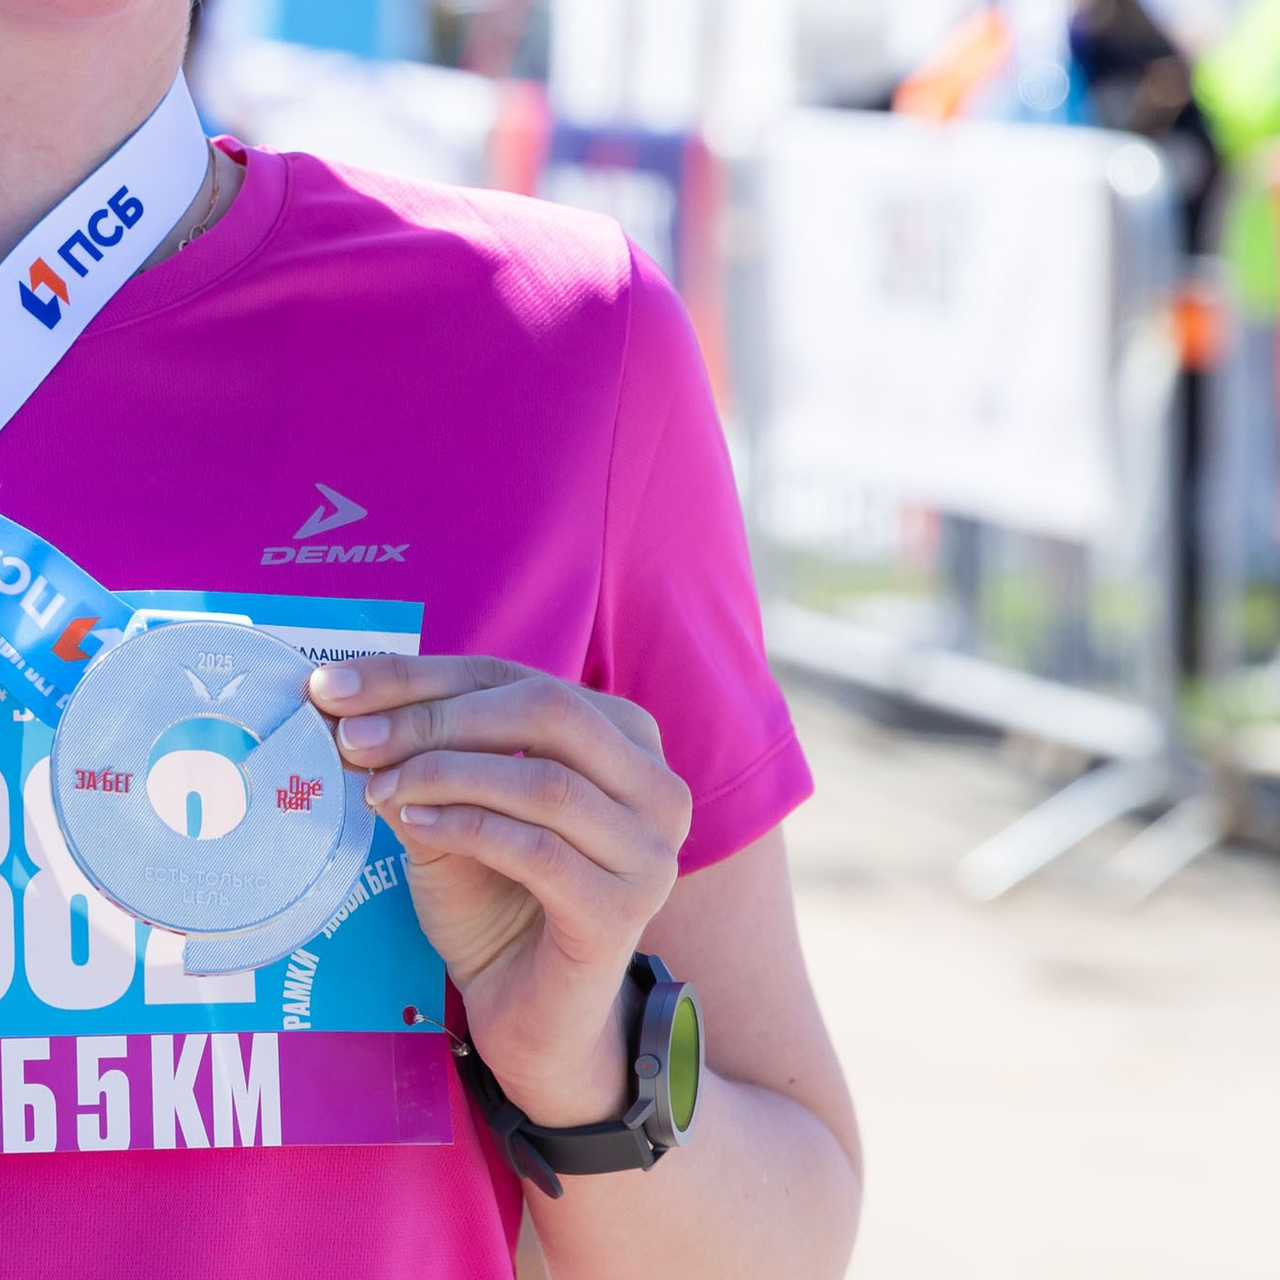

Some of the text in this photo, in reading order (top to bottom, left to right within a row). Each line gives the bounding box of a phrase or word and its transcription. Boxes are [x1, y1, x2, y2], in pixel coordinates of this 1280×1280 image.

[57, 185, 144, 278] ПСБ
[261, 544, 410, 565] DEMIX
[197, 652, 234, 670] 2025
[144, 866, 269, 890] ЕСТЬ ТОЛЬКО
[183, 889, 230, 906] ЦЕЛЬ
[283, 948, 320, 1030] РАМКИ
[368, 856, 398, 895] БЕГ
[76, 1035, 131, 1151] 5
[151, 1032, 283, 1150] КМ
